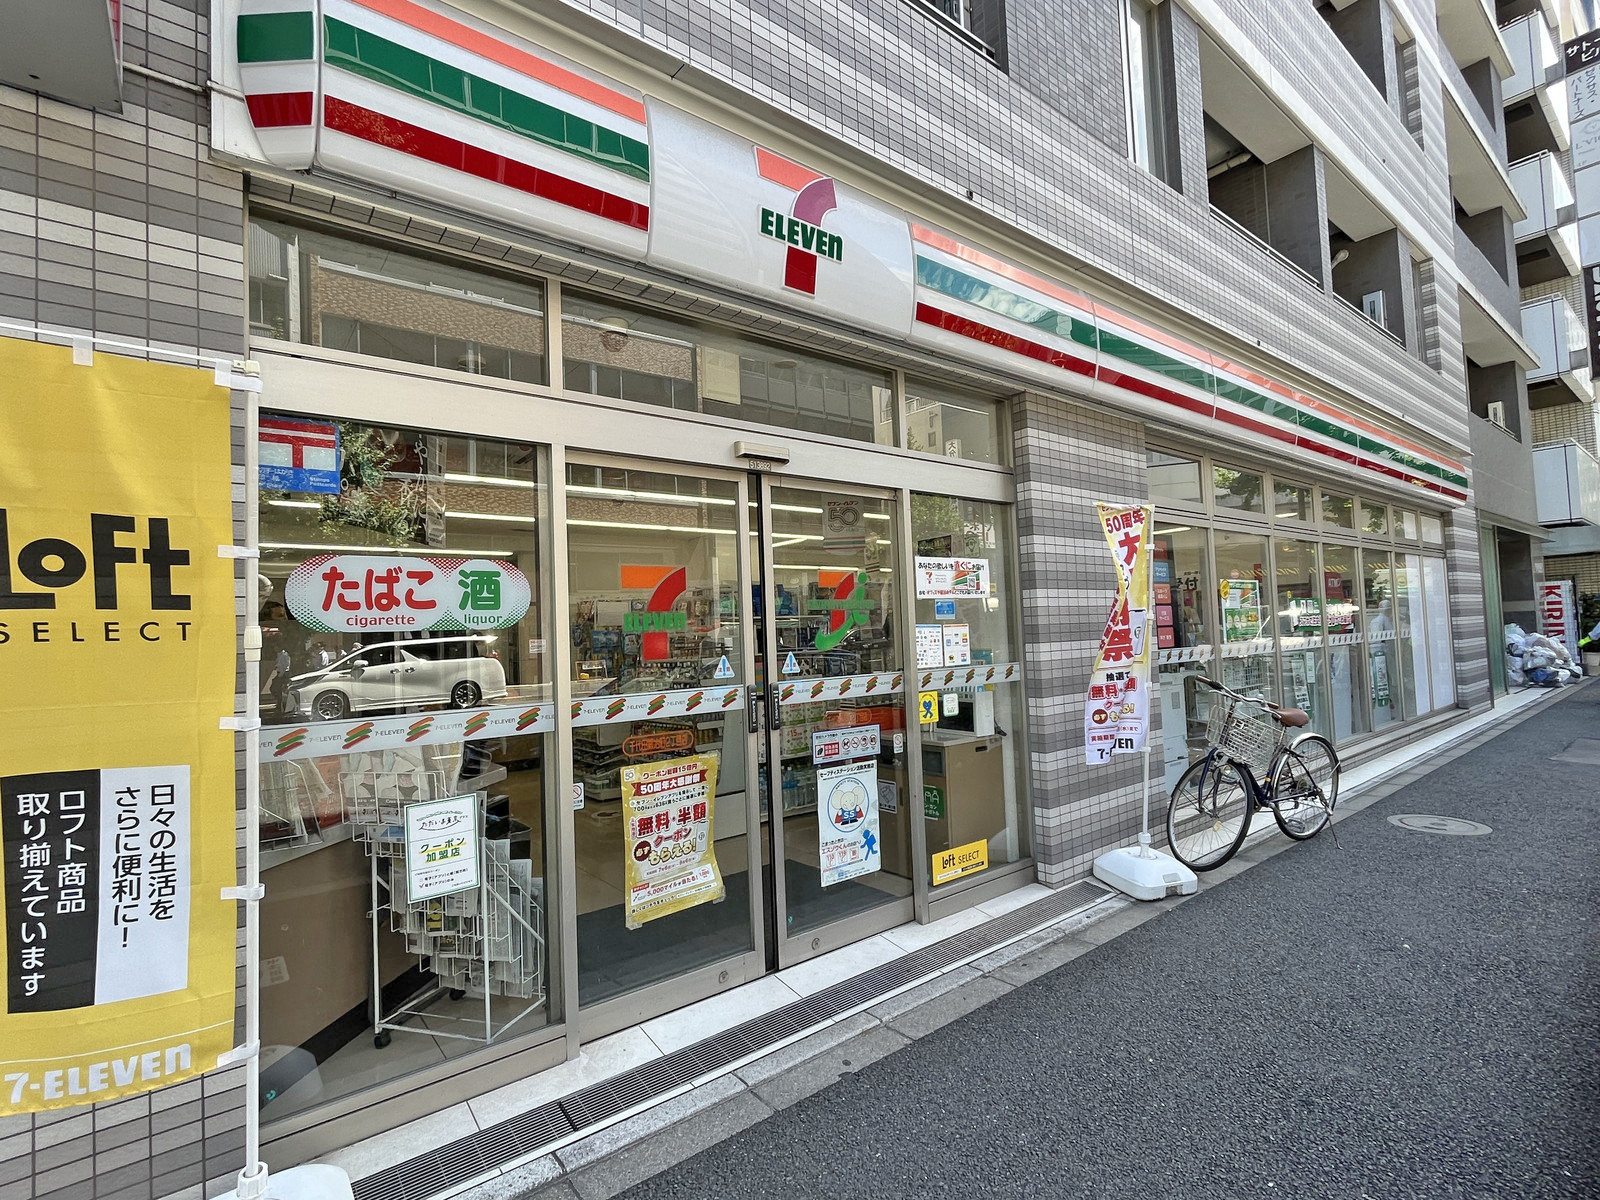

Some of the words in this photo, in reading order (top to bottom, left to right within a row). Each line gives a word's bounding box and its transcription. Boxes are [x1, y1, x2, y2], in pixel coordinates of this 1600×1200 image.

[322, 566, 437, 612] たばこ
[458, 569, 501, 611] 酒
[346, 614, 416, 627] cigarette
[463, 614, 503, 626] liquor
[56, 789, 86, 914] ロフト商品
[148, 784, 178, 921] 日々の生活を
[421, 837, 465, 853] クーポン
[653, 827, 692, 847] クーポン
[111, 786, 142, 948] さらに便利に!
[427, 847, 461, 863] 加盟店
[958, 850, 979, 864] SELECT
[16, 792, 51, 996] 取り揃えています
